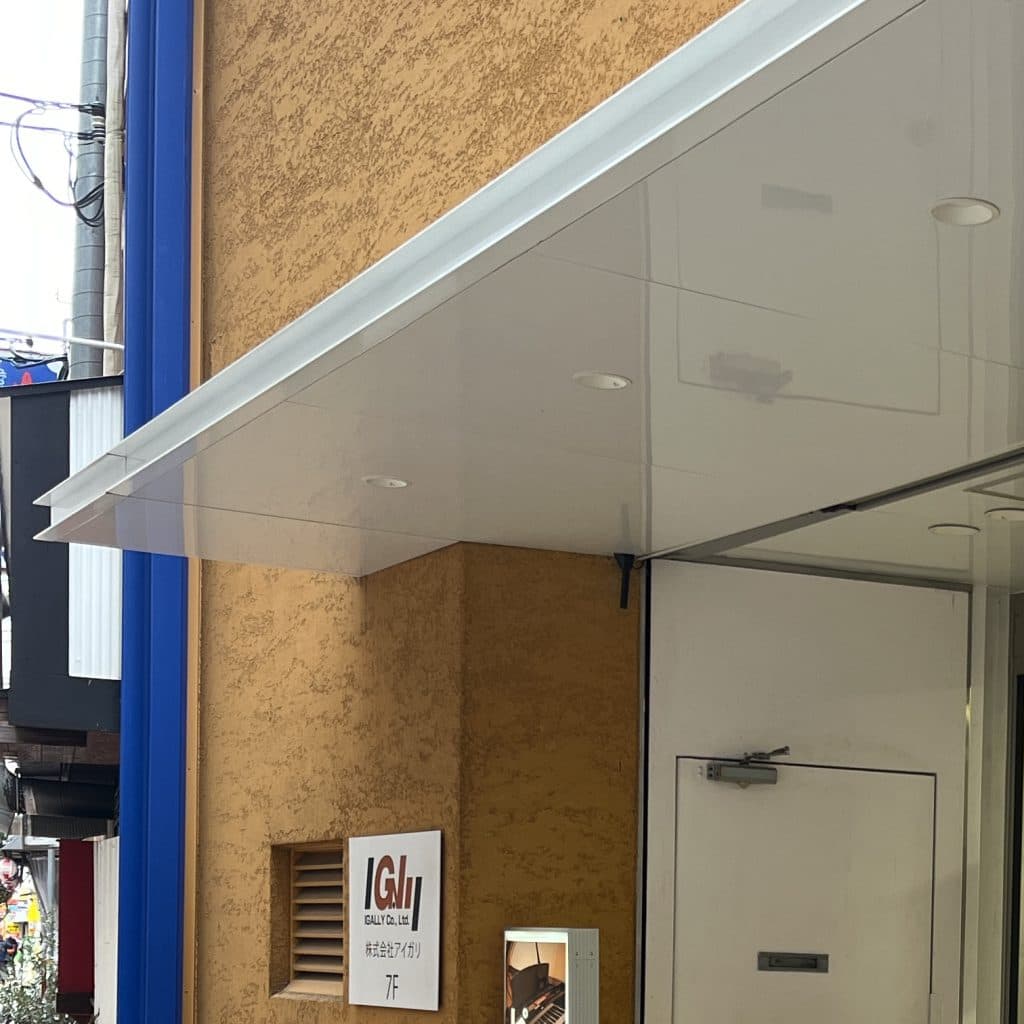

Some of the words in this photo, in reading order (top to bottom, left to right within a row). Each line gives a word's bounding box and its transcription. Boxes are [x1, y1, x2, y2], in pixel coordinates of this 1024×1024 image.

[364, 914, 385, 926] IGALLY
[365, 941, 421, 959] 株式会社アイガリ
[385, 974, 399, 1000] 7F
